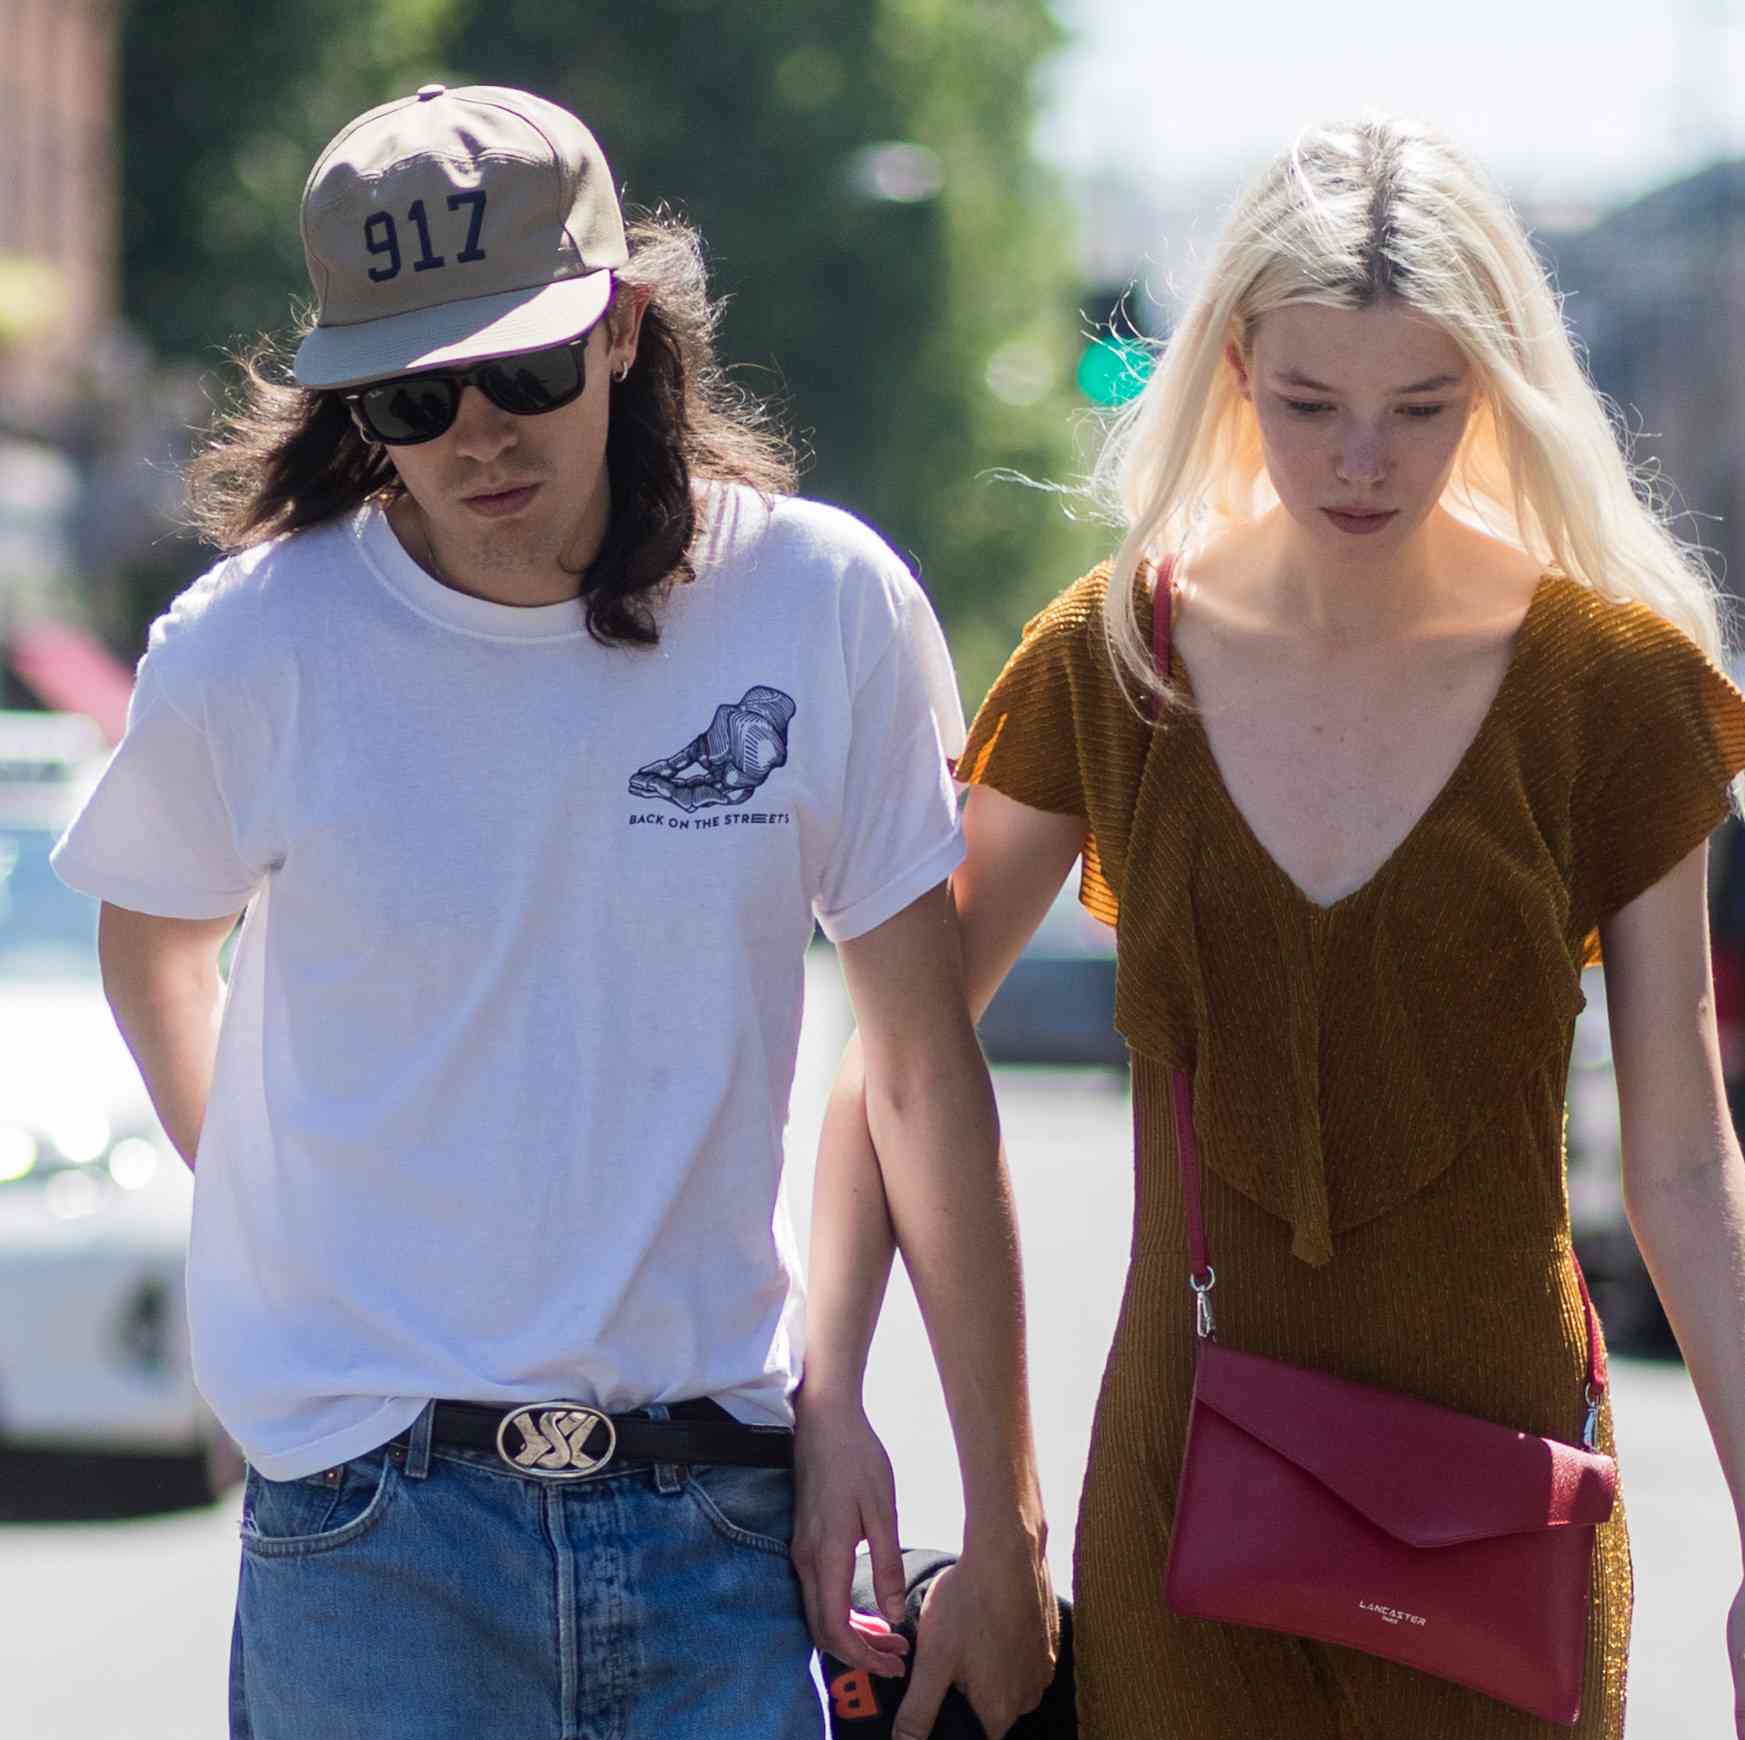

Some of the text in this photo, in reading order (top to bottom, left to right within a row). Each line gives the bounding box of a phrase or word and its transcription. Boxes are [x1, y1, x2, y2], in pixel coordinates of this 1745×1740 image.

[363, 190, 488, 283] 917
[629, 813, 665, 825] BACK
[668, 817, 689, 830] ON
[694, 815, 720, 830] THE
[1359, 1599, 1427, 1627] LANCASTER
